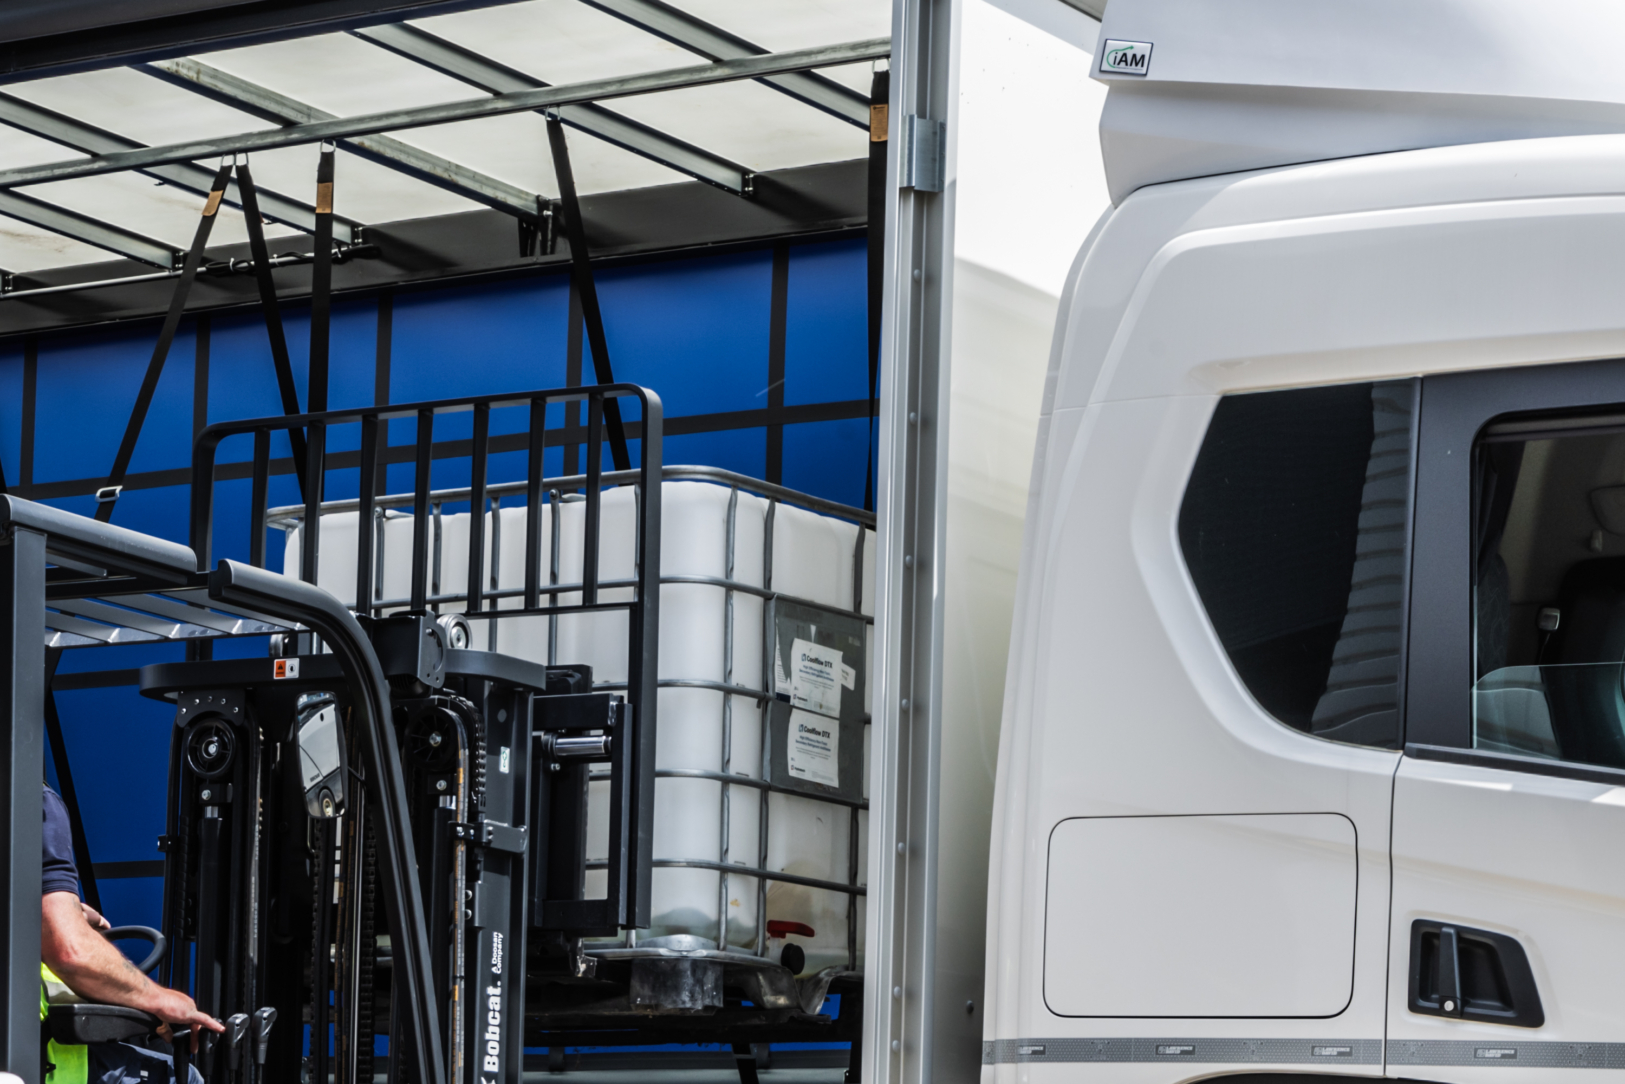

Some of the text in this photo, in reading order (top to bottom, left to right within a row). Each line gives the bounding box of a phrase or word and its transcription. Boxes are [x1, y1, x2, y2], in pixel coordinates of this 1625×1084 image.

[1113, 51, 1146, 68] iAM
[806, 655, 833, 669] Coolflow DTX
[804, 726, 831, 739] Coolflow DTX
[491, 931, 499, 965] Doosan
[496, 932, 504, 974] Company
[483, 985, 502, 1073] Bobcat
